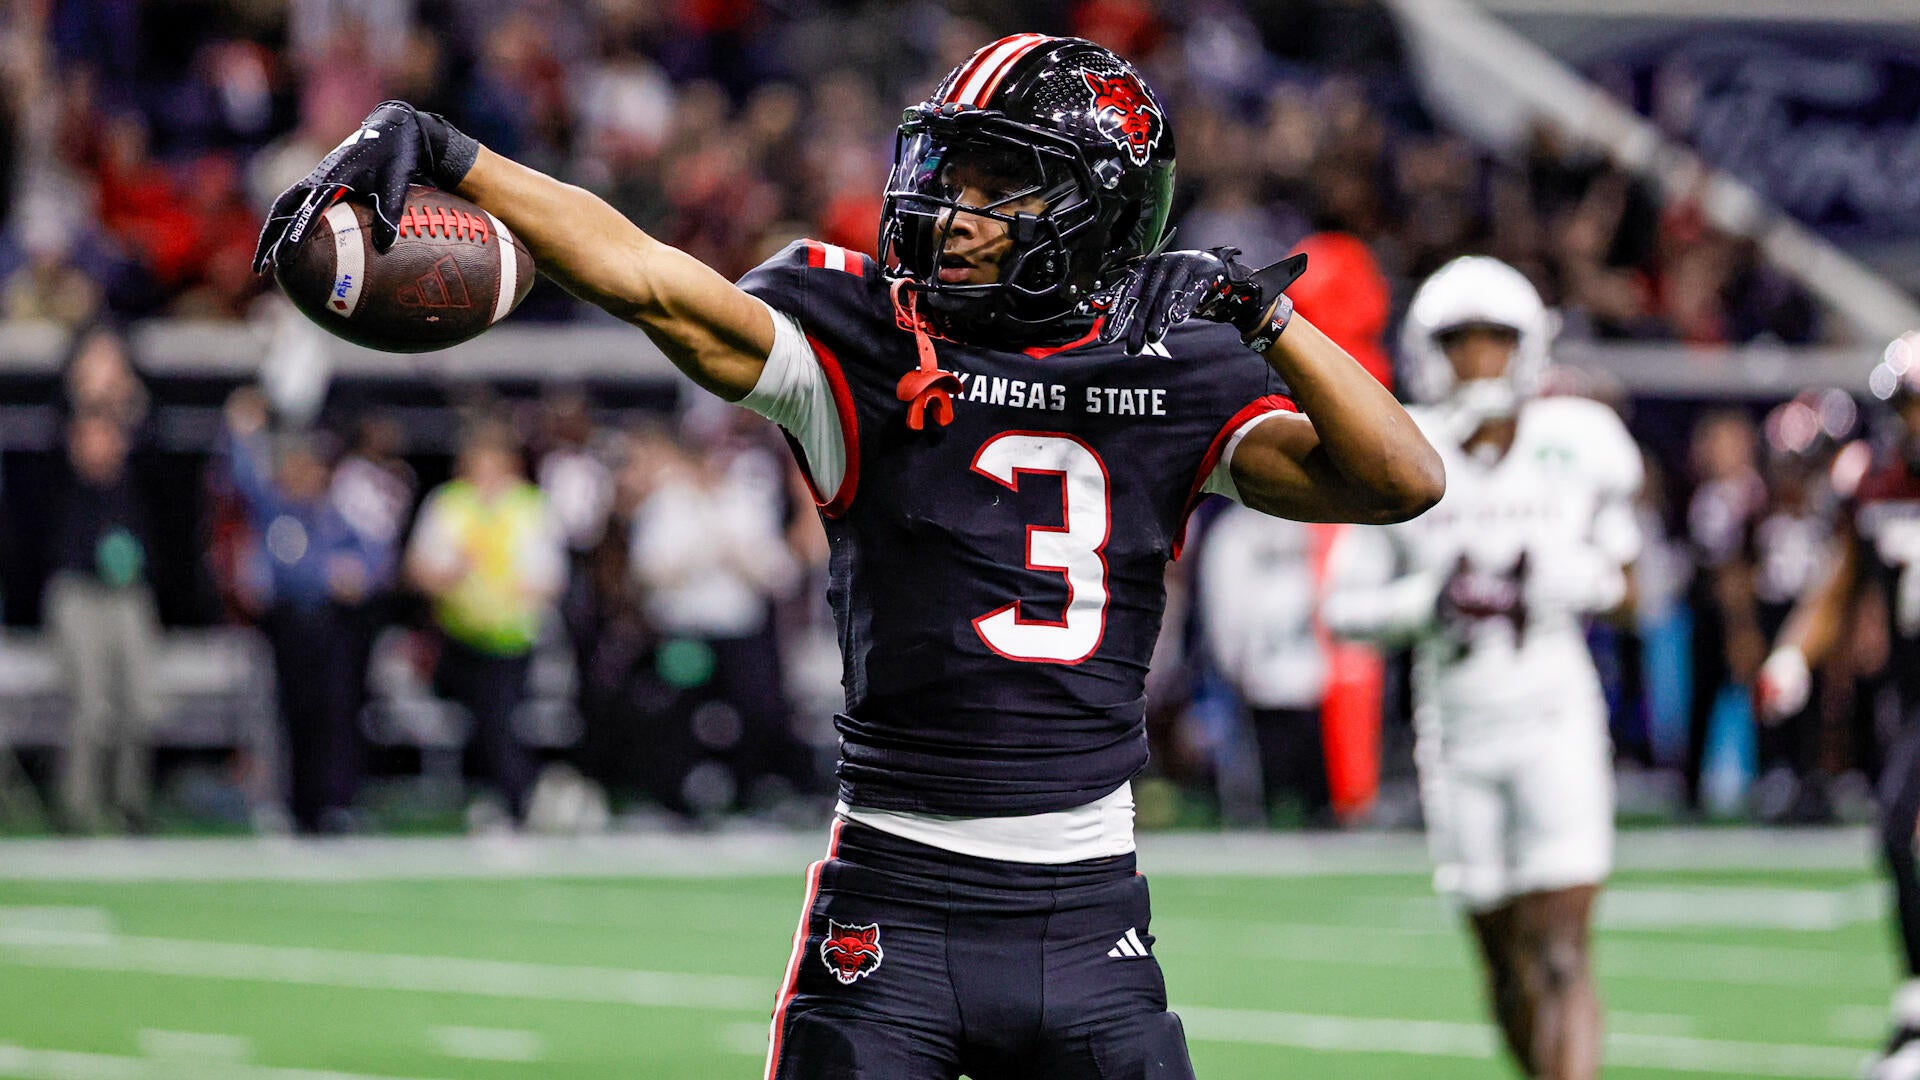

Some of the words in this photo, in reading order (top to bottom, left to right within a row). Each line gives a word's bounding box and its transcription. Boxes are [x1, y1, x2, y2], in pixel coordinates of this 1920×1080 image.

[289, 202, 315, 242] ADIZERO
[915, 366, 1066, 411] KANSAS
[1086, 386, 1167, 416] STATE
[969, 429, 1112, 666] 3
